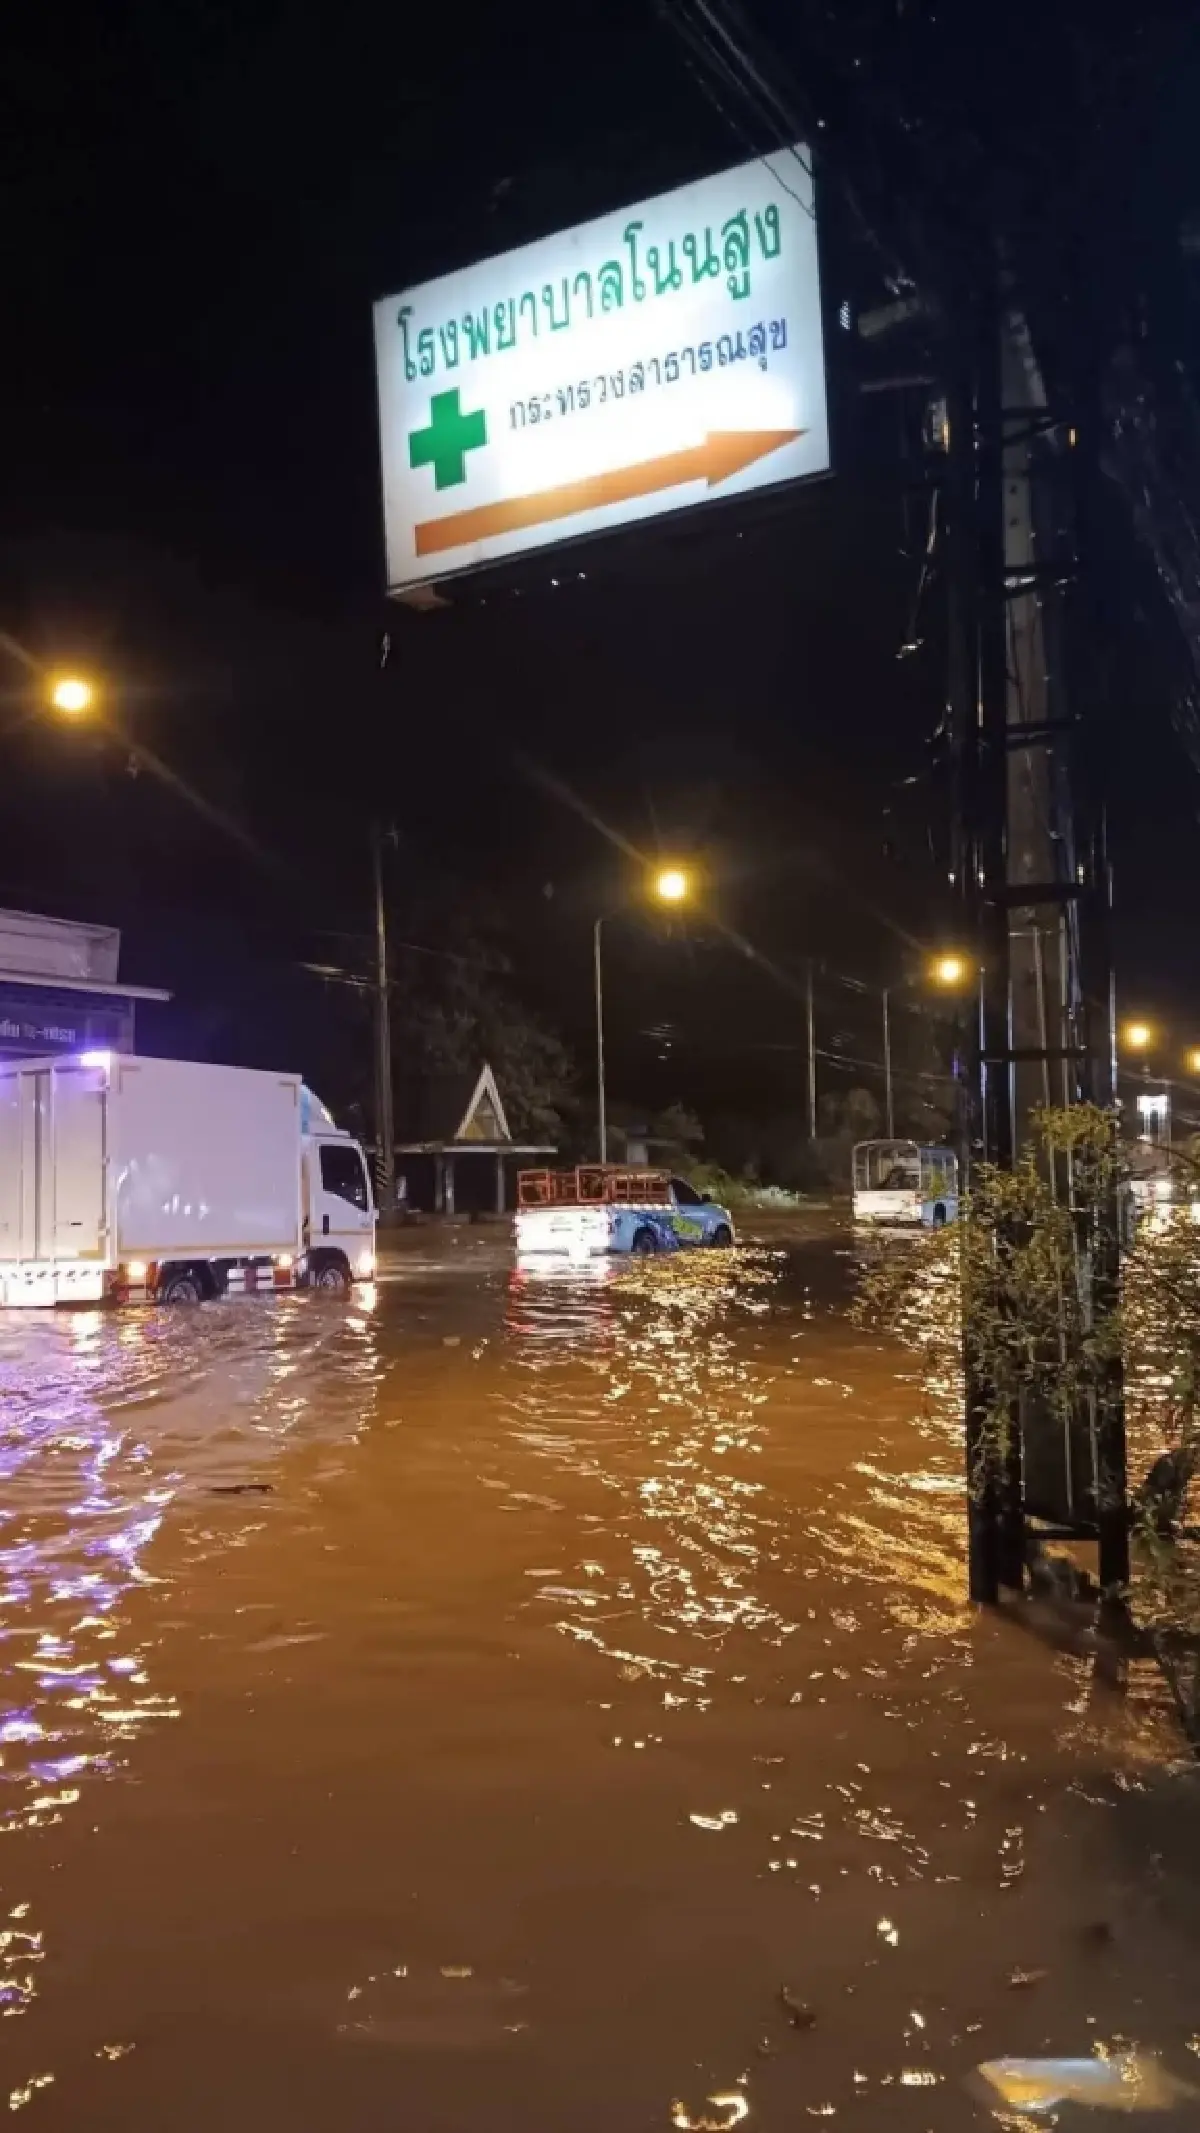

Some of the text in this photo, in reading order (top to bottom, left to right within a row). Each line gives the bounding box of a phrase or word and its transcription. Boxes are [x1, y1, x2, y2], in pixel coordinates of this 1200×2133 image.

[397, 204, 782, 382] โรงพยาบาลโนนสูง
[509, 317, 787, 430] กระทรวงสาธารณสุข
